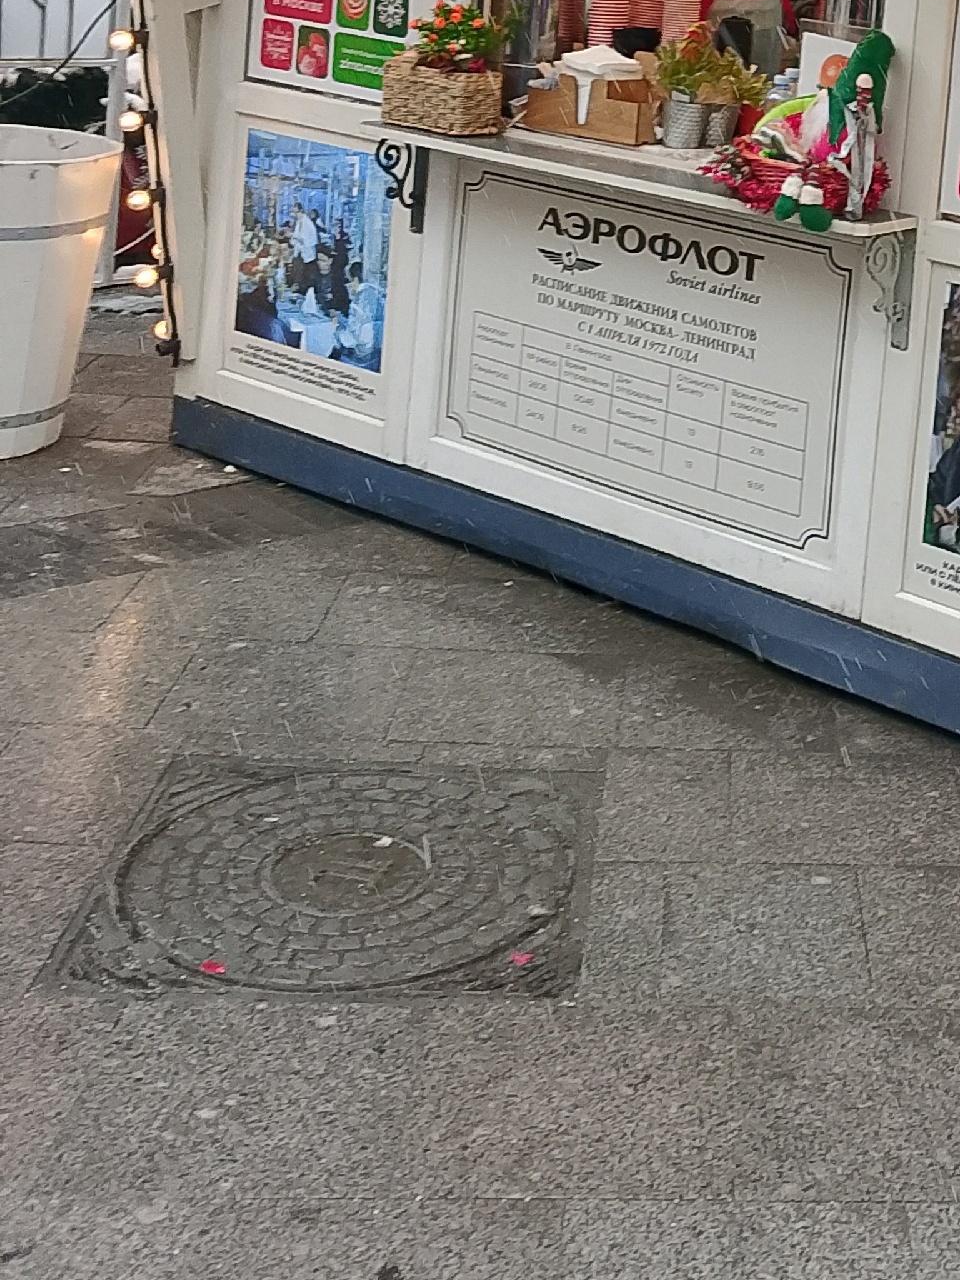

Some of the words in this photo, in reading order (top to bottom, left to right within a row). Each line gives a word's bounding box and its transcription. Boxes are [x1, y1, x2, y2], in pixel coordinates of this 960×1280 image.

[538, 207, 766, 281] АЭРОФЛОТ
[532, 273, 608, 303] РАСПИСАНИЕ
[610, 293, 678, 320] ДВИЖЕНИЯ
[681, 312, 758, 341] САМОЛЕТОВ
[666, 270, 706, 291] Soviet
[708, 282, 761, 305] airlines
[537, 292, 554, 306] ПО
[557, 297, 621, 324] МАРШРУТУ
[681, 331, 757, 361] ЛЕНИНГРАД
[577, 321, 586, 331] С
[593, 326, 641, 347] АПРЕЛЯ
[642, 338, 667, 354] 1972
[668, 343, 700, 363] ГОДА
